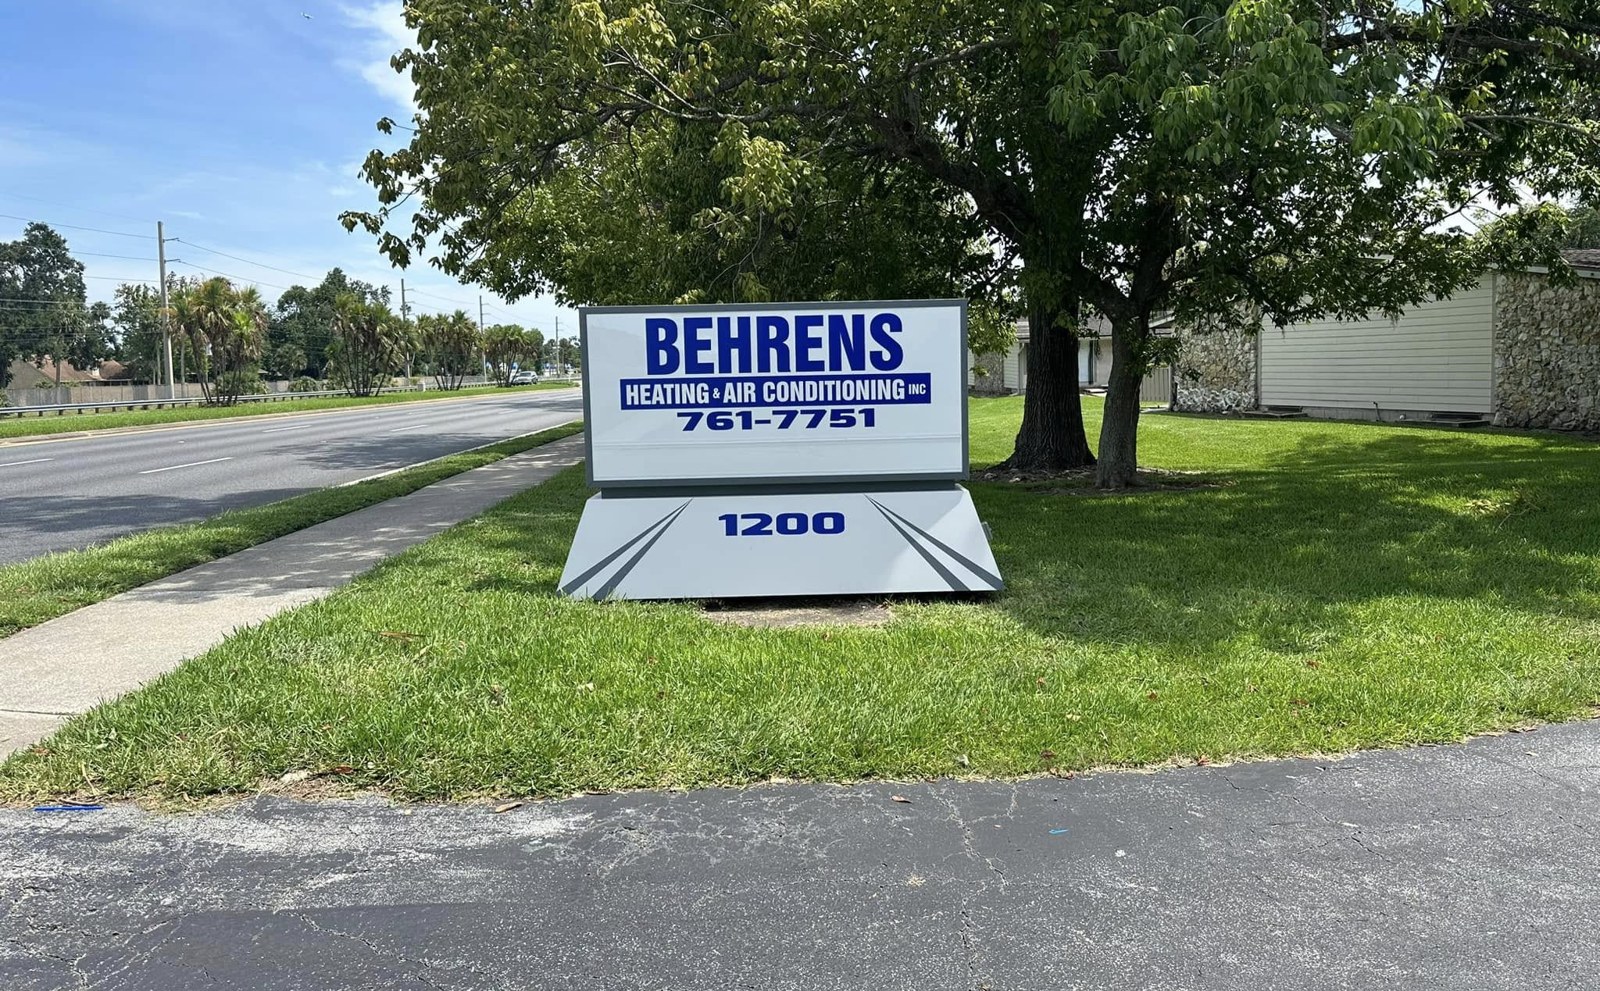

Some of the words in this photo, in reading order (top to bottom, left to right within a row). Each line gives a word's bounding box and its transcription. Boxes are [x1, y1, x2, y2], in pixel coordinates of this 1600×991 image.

[645, 313, 904, 375] BEHRENS
[625, 383, 709, 406] HEATING
[712, 388, 721, 400] &
[723, 382, 756, 403] AIR
[762, 379, 905, 402] CONDITIONING
[908, 383, 927, 396] INC
[677, 408, 876, 431] 761-7751
[718, 512, 846, 537] 1200
